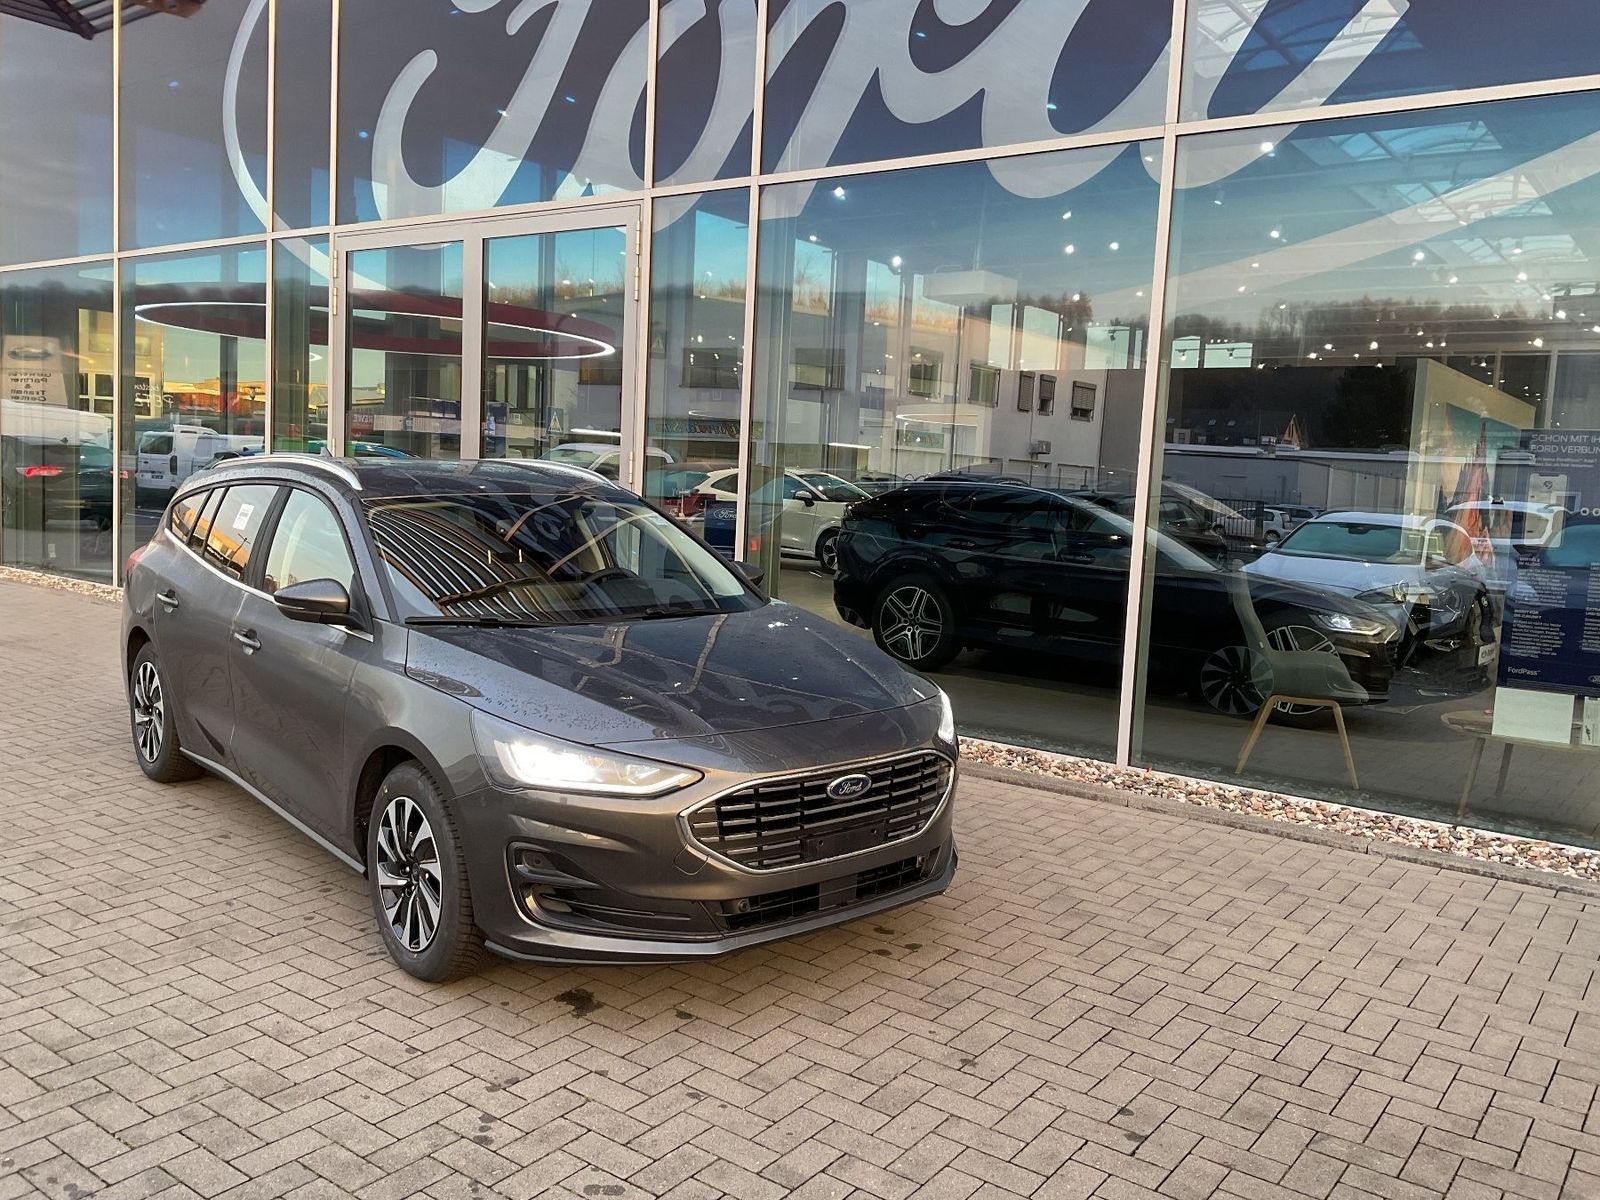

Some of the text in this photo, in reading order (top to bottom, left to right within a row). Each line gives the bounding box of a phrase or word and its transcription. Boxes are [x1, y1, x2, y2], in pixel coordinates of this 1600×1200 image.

[1531, 434, 1568, 443] SCHON
[1570, 434, 1589, 443] MIT
[1530, 444, 1559, 453] FORD
[838, 778, 864, 796] Ford
